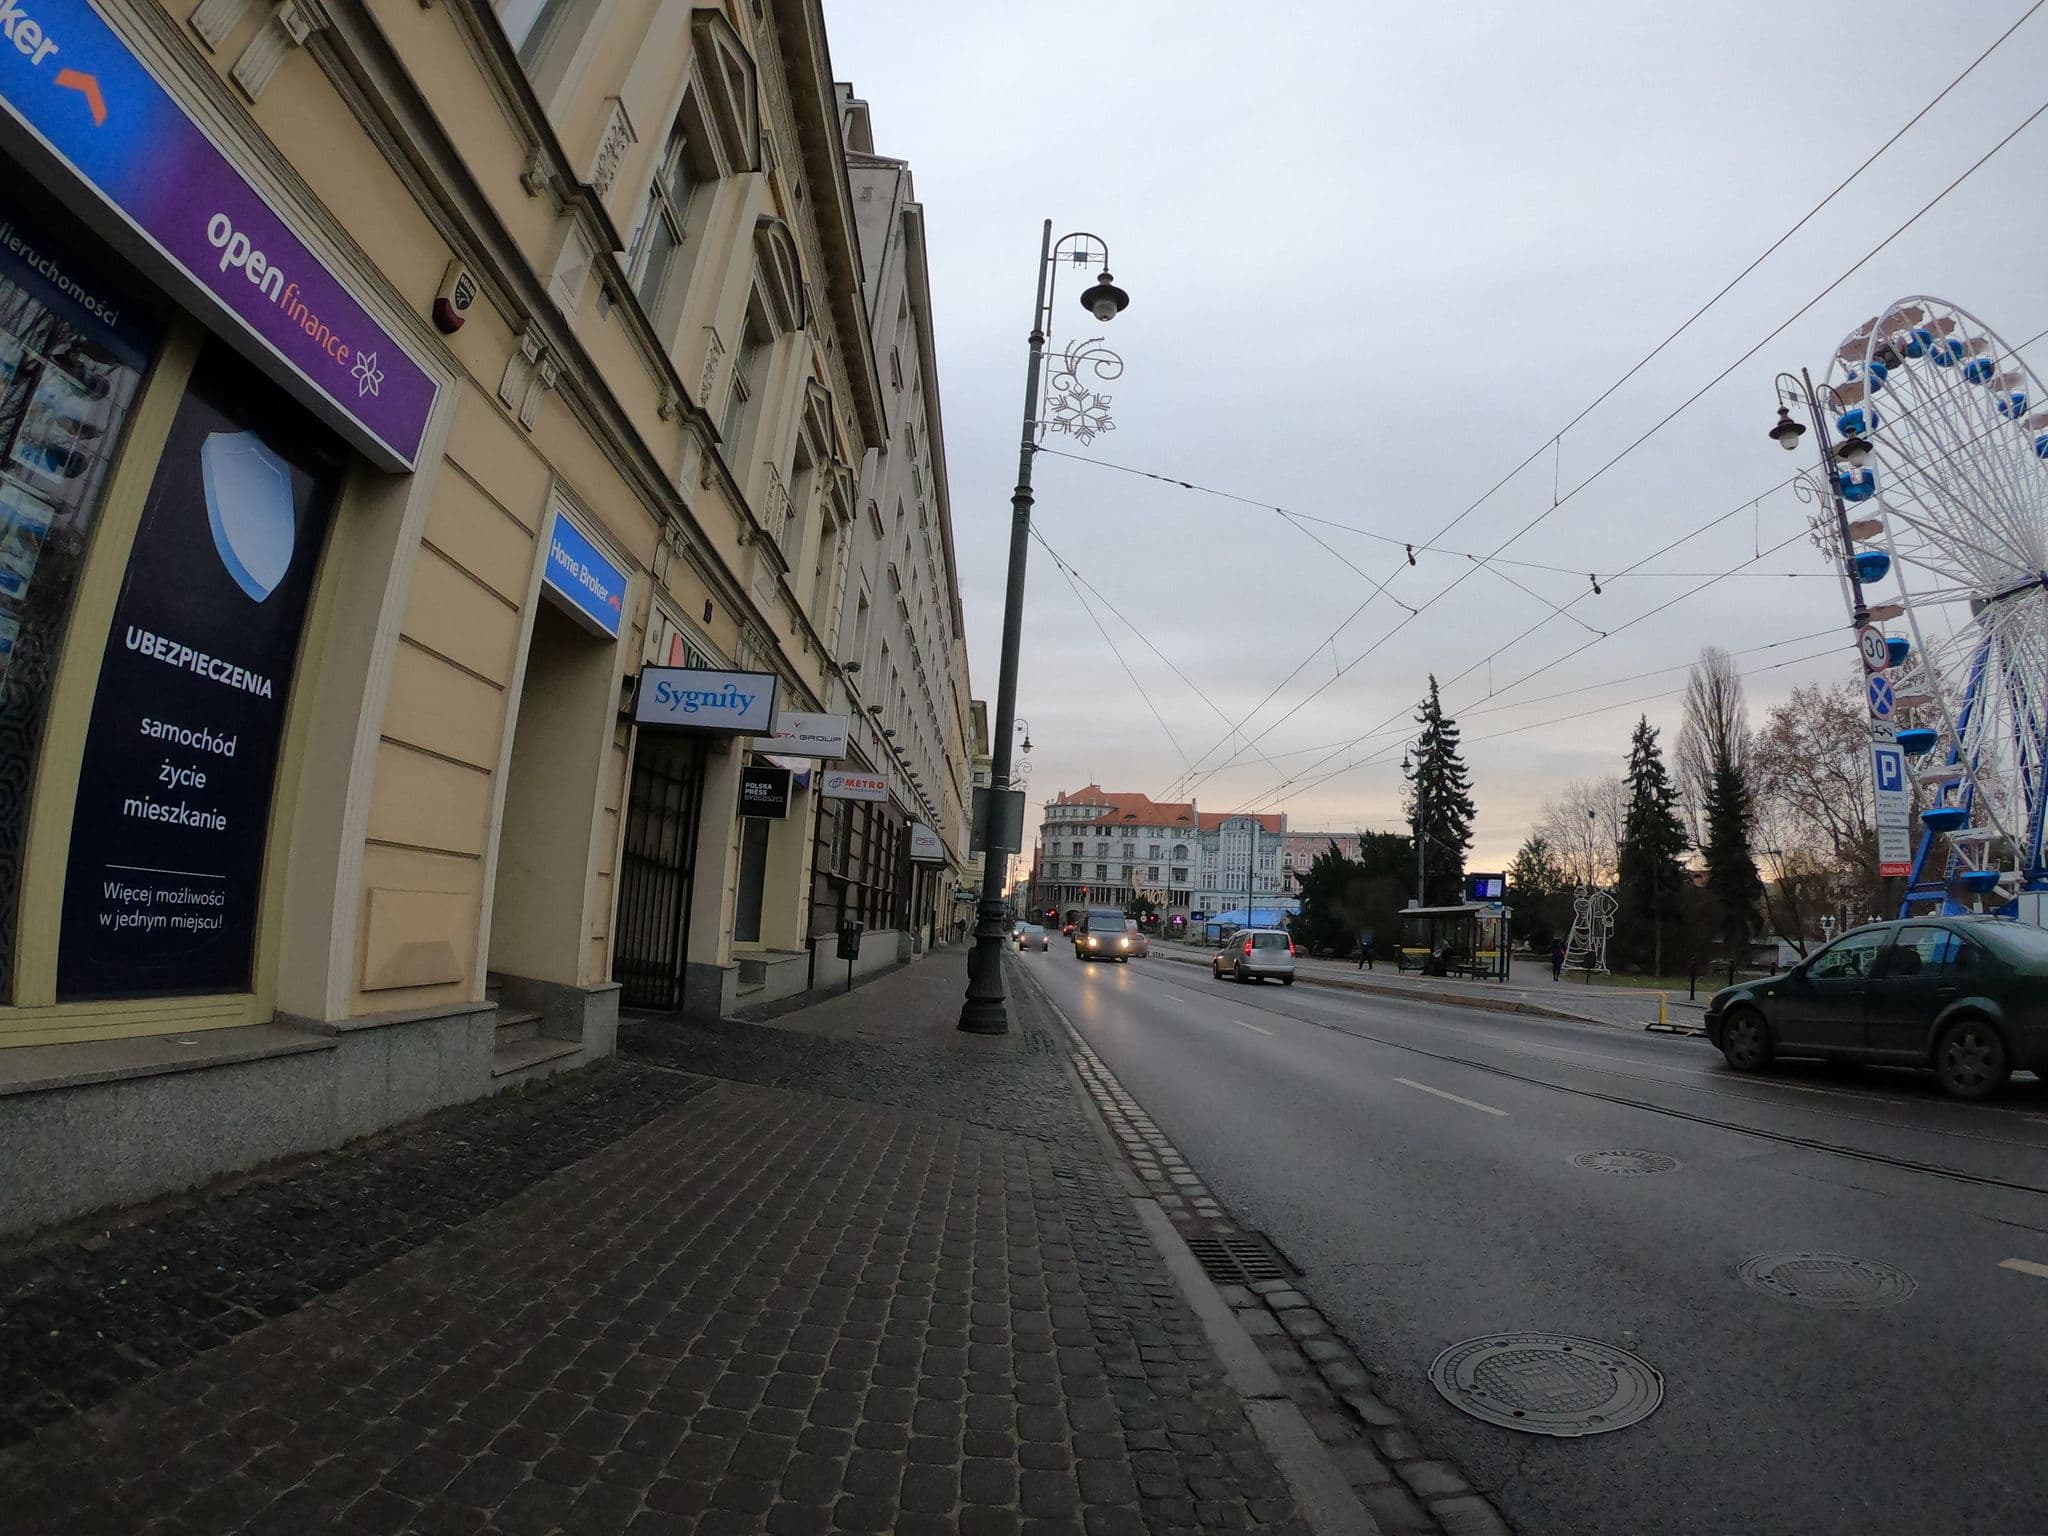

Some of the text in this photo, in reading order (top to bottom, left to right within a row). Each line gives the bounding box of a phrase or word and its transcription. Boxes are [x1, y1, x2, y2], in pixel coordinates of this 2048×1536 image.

[0, 0, 59, 66] ker
[206, 212, 350, 366] open finance
[550, 538, 609, 602] Home Broker
[125, 625, 273, 699] UBEZPIECZENIA
[1864, 636, 1885, 660] 30
[655, 681, 756, 716] Sygnity
[140, 716, 238, 758] samochód
[774, 732, 842, 743] STA GROUP
[158, 758, 207, 789] życie
[745, 782, 773, 790] POLSKA
[845, 778, 885, 790] METRO
[1880, 754, 1897, 787] P
[744, 788, 768, 796] PRESS
[123, 796, 227, 831] mieszkanie
[103, 881, 225, 907] Więcej możliwości
[99, 910, 224, 933] w jednym miejscu!
